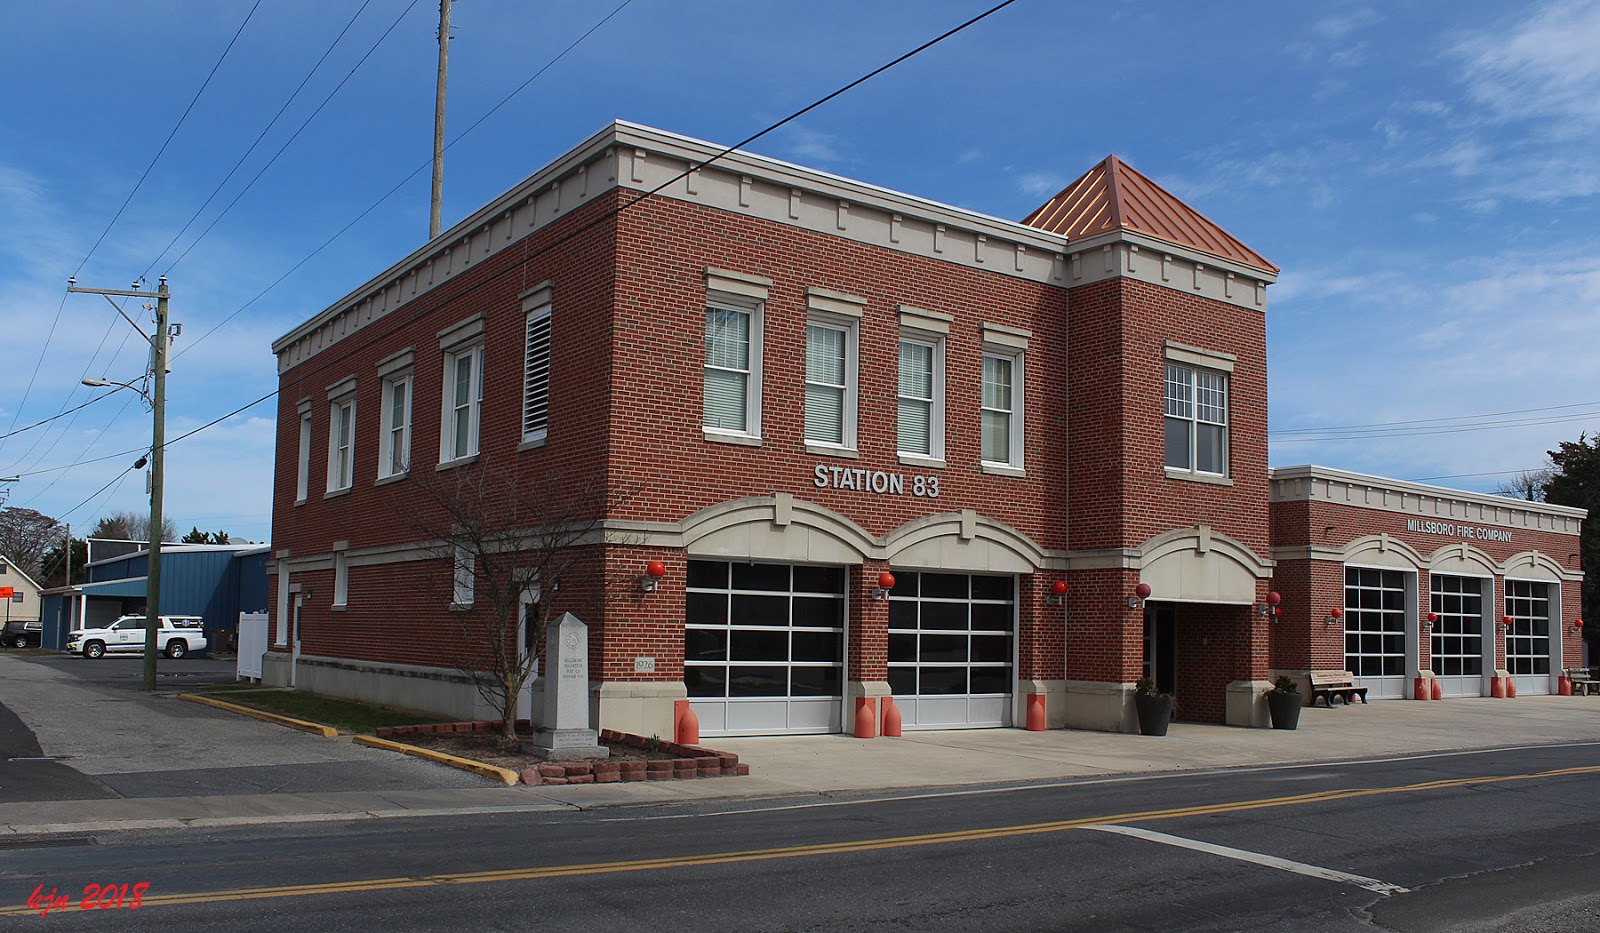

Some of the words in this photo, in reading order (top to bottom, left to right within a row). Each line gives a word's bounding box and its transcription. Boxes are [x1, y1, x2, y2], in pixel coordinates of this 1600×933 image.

[814, 464, 904, 495] STATION
[913, 475, 940, 498] 83
[1407, 519, 1454, 536] MILLSBORO
[1457, 525, 1474, 539] FIRE
[1476, 527, 1512, 542] COMPANY
[636, 660, 654, 669] 1926
